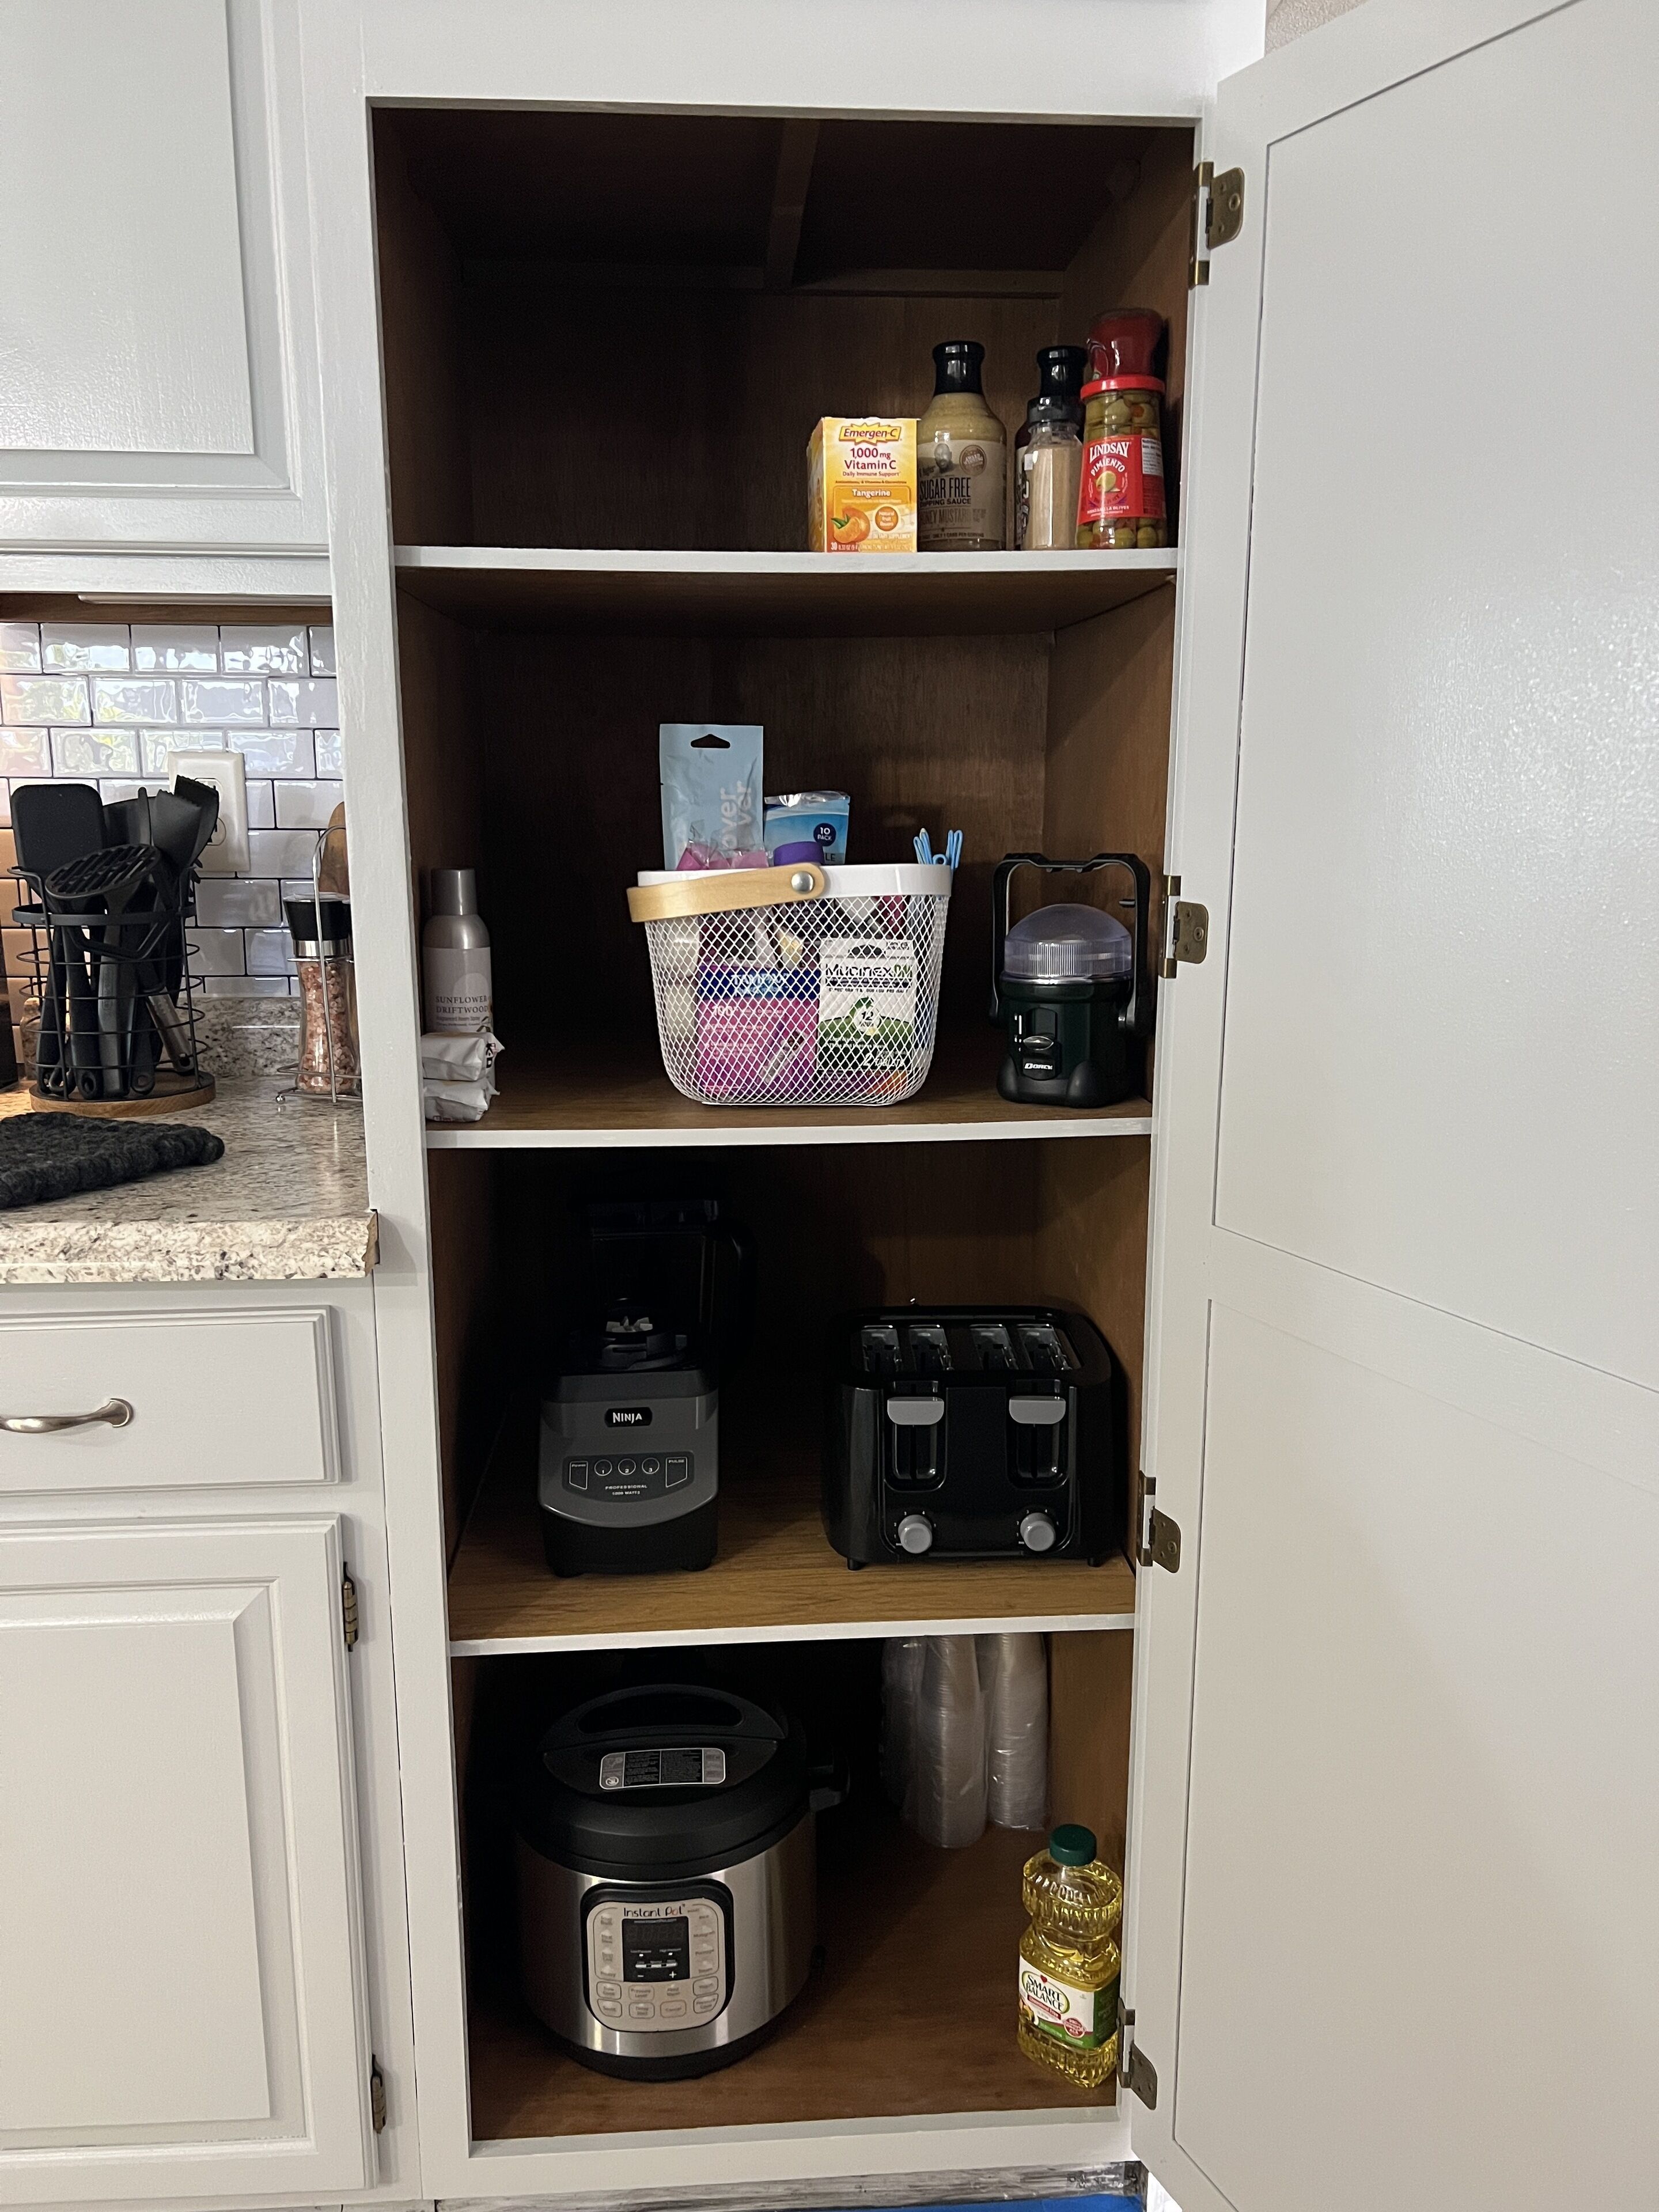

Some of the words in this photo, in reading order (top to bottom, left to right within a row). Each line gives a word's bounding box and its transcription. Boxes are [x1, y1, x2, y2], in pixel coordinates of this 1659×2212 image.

[843, 428, 898, 440] Emergen-C
[850, 448, 878, 459] 1,000
[880, 452, 891, 460] mg
[1089, 442, 1130, 463] LINDSAY
[844, 460, 887, 469] Vitamin
[889, 460, 896, 469] C
[1090, 457, 1126, 476] PIMIENTO
[853, 488, 891, 499] Tangerine
[919, 478, 946, 501] SUGAR
[949, 477, 972, 499] FREE
[820, 827, 831, 835] 10
[435, 995, 488, 1004] SUNFLOWER
[436, 1005, 488, 1014] DRIFTWOOD
[612, 1412, 643, 1424] NINJA
[624, 1907, 661, 1918] Instant
[665, 1905, 683, 1916] Pot
[1027, 1974, 1060, 2002] SMART
[1025, 1982, 1065, 2012] BALANCE
